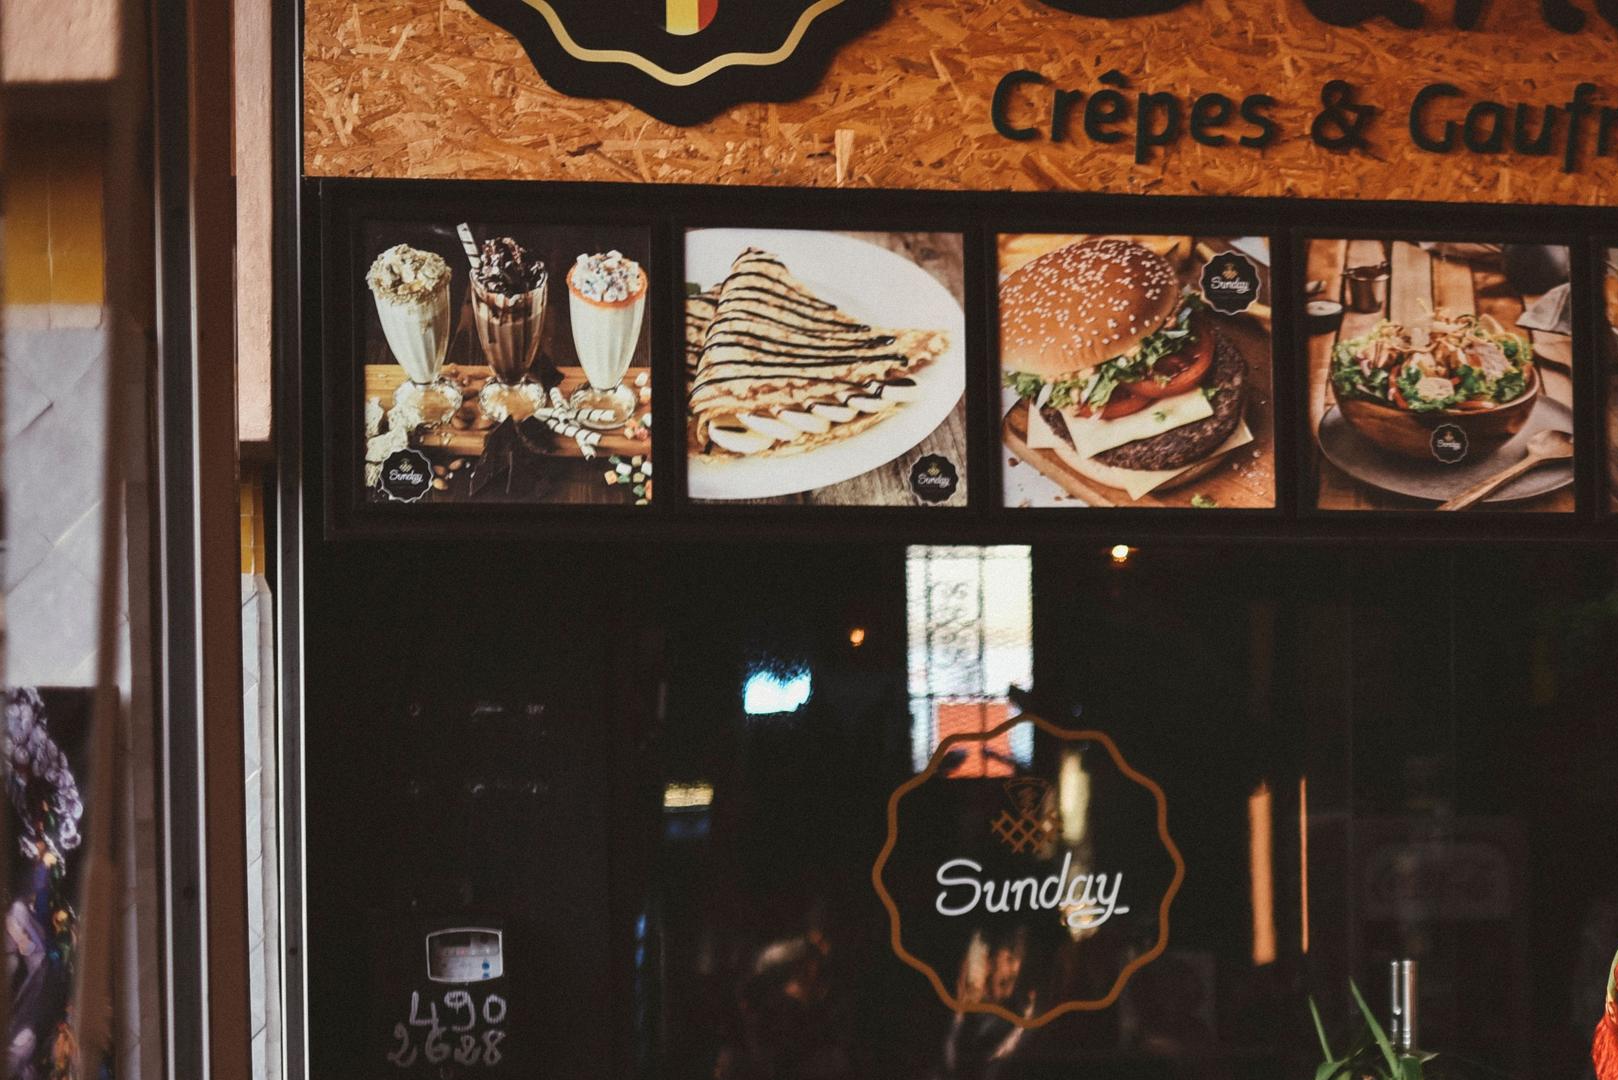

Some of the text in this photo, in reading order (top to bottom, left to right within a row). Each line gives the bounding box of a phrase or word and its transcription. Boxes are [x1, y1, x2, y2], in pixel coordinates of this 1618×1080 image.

[990, 62, 1280, 156] Crêpes
[1312, 80, 1378, 152] &
[934, 850, 1131, 930] Sunday
